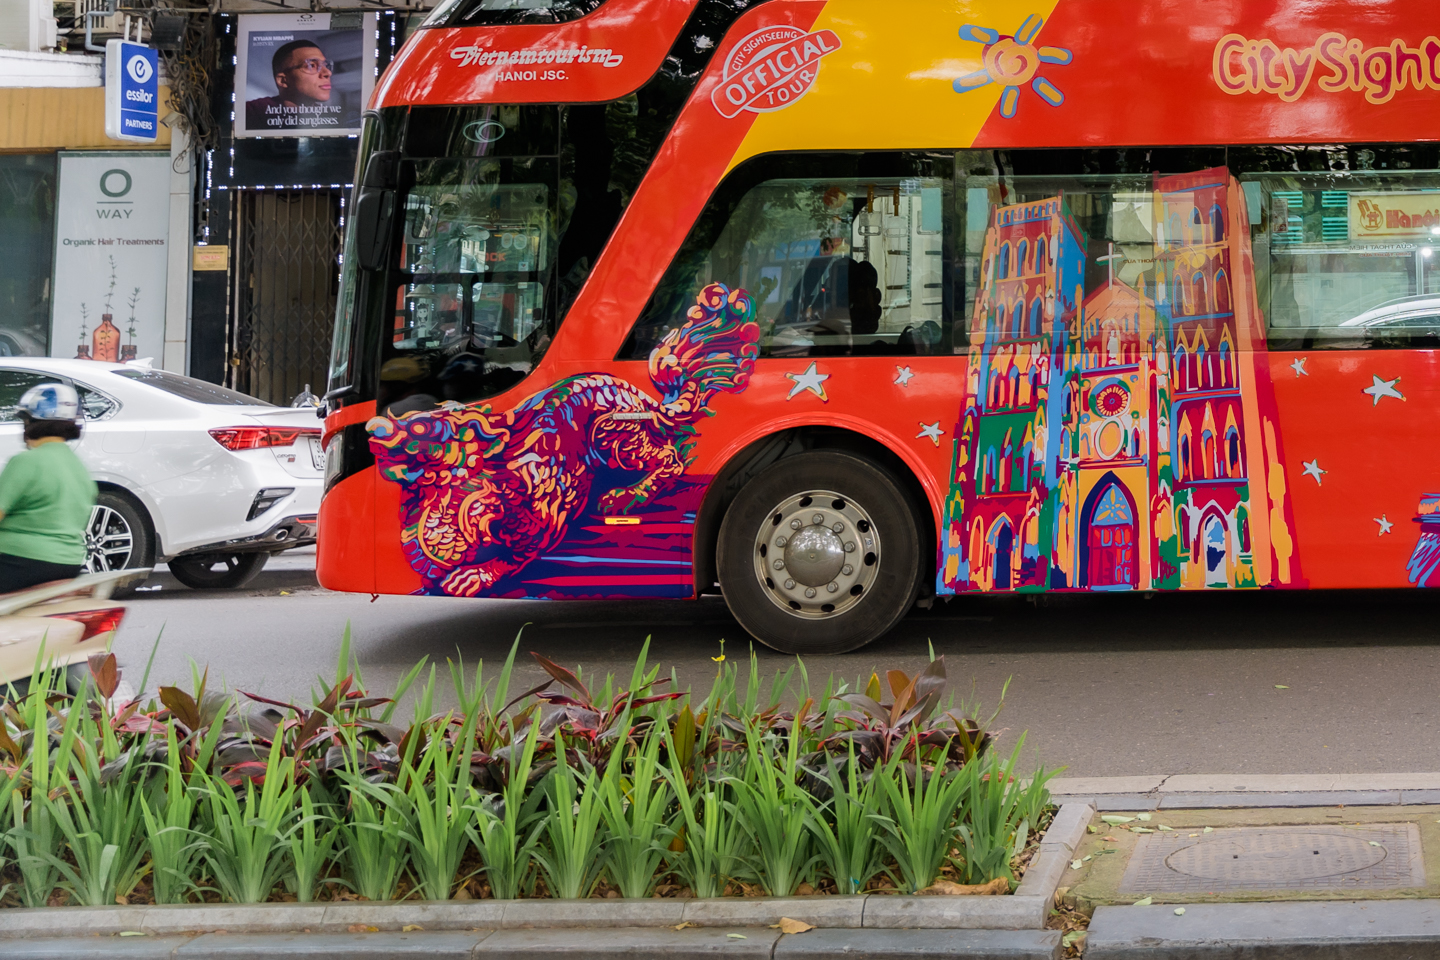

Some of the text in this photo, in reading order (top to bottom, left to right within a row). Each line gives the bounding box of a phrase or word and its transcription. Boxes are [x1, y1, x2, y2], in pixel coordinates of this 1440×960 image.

[450, 45, 623, 68] Vietnamtourism
[732, 31, 798, 71] CITY SIGHTSEEING
[495, 70, 569, 82] HANOI JSC.
[725, 34, 834, 106] OFFICIAL
[766, 69, 815, 105] TOUR
[126, 89, 153, 103] essilor
[265, 104, 282, 114] And
[283, 107, 297, 116] you
[298, 104, 328, 116] thought
[125, 118, 153, 130] PARTNERS
[267, 115, 339, 128] only did sunglasses.
[100, 169, 132, 198] O
[96, 209, 133, 219] WAY
[62, 237, 165, 248] Organic Hair Treatments
